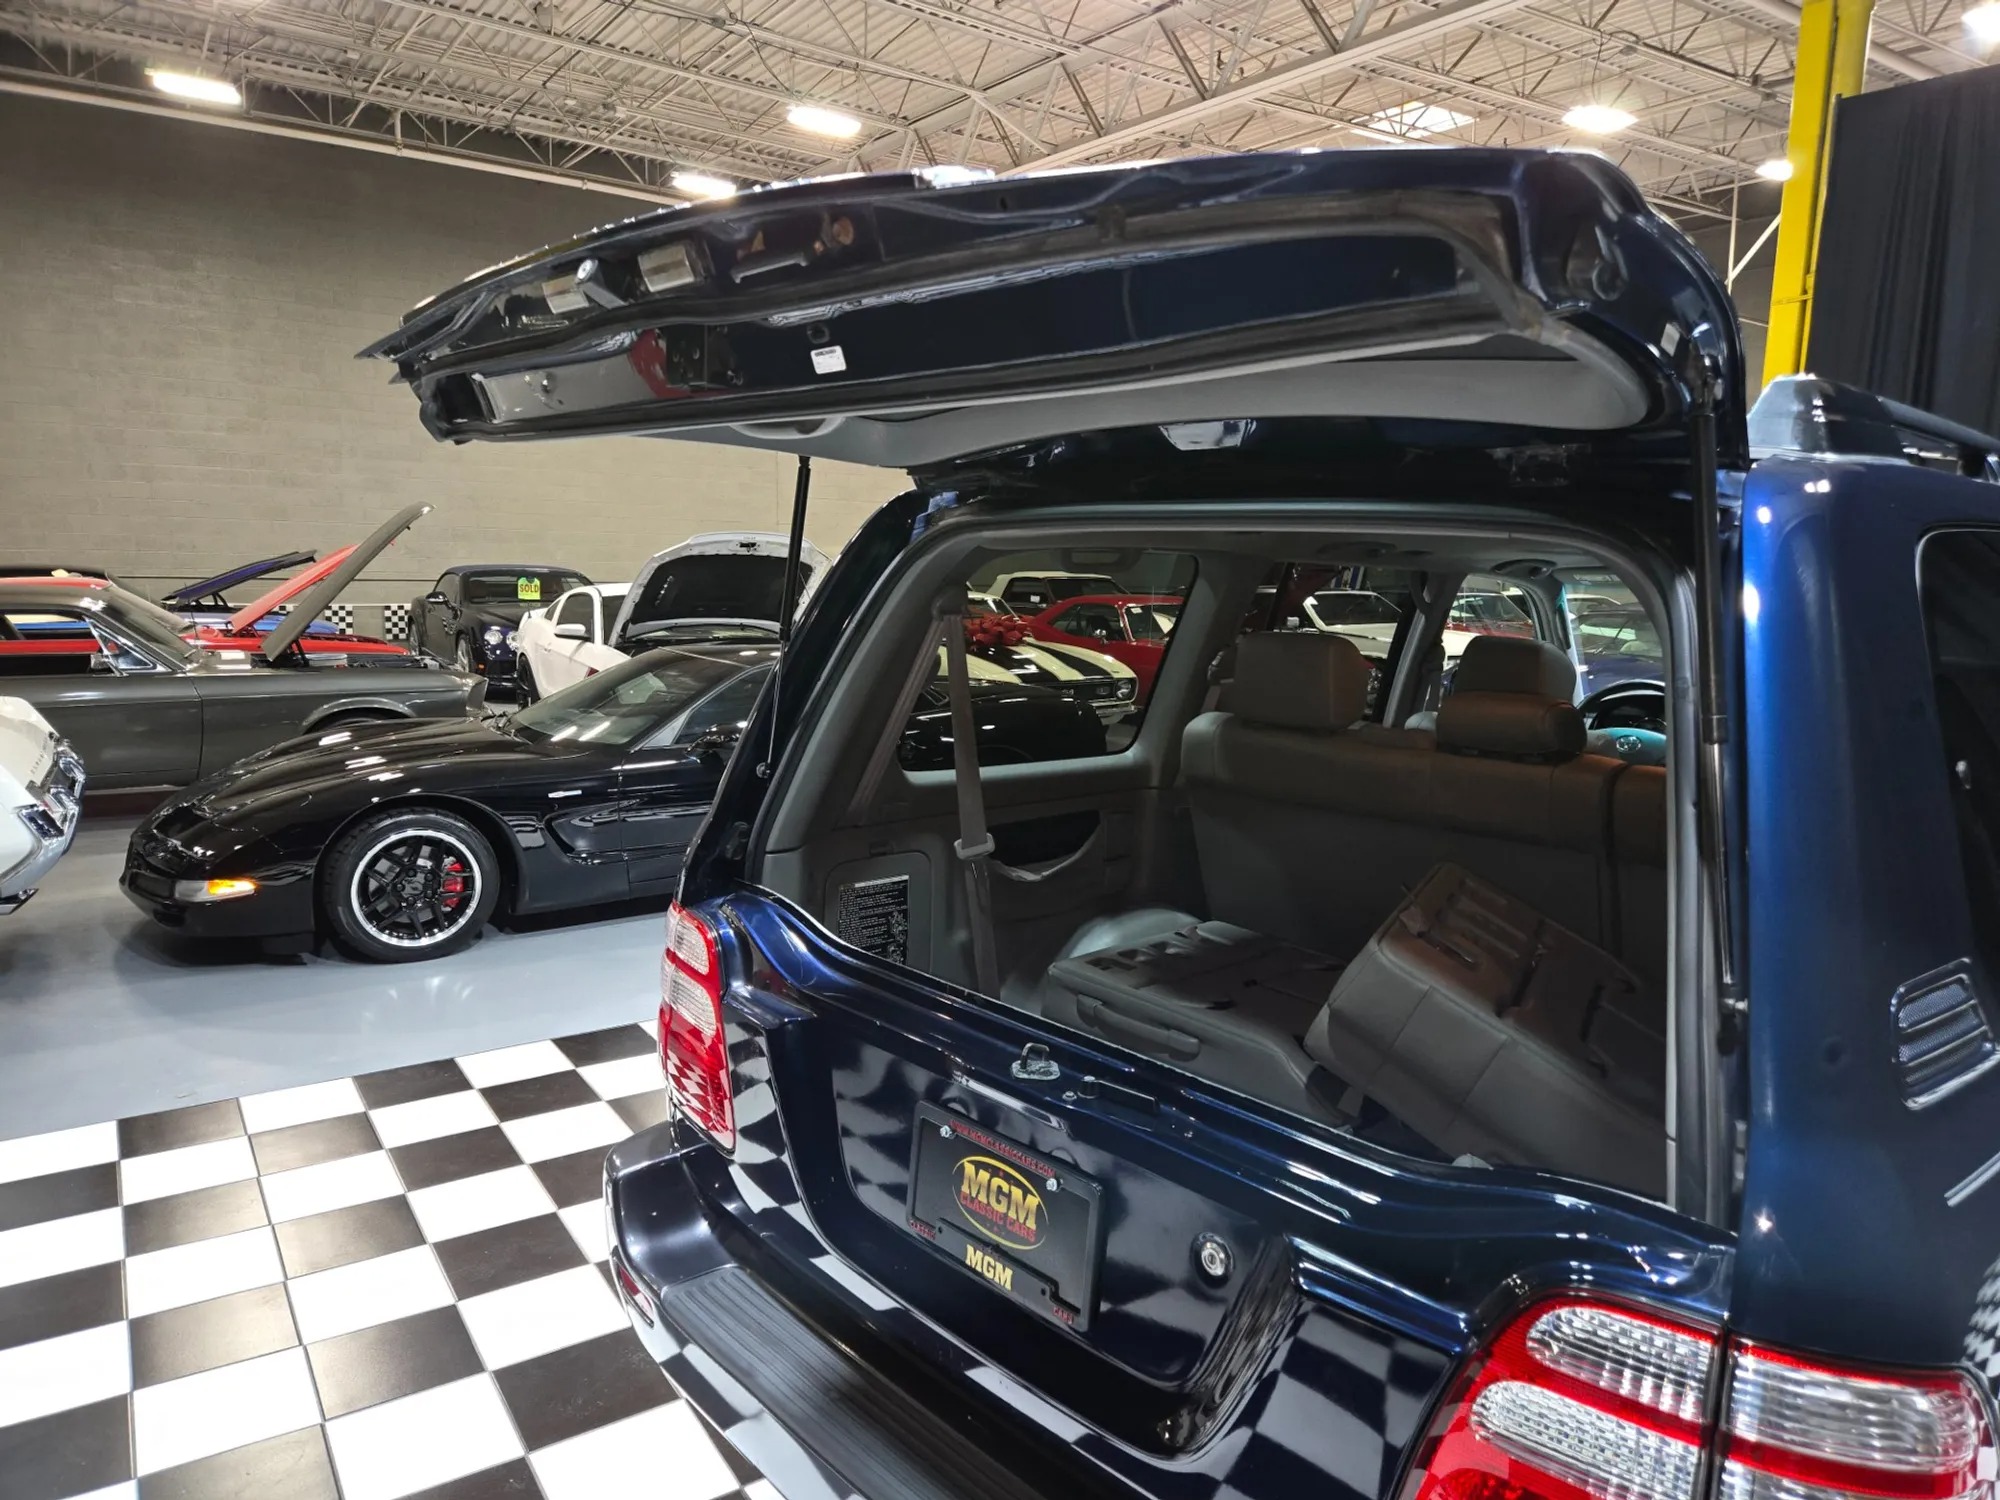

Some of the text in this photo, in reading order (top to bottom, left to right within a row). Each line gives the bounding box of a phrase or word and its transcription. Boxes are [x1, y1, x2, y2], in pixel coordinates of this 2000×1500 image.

[519, 584, 539, 593] SOLD
[960, 1191, 1037, 1244] CLASSIC CARS
[961, 1160, 1040, 1230] MGM
[965, 1244, 1013, 1291] MGM
